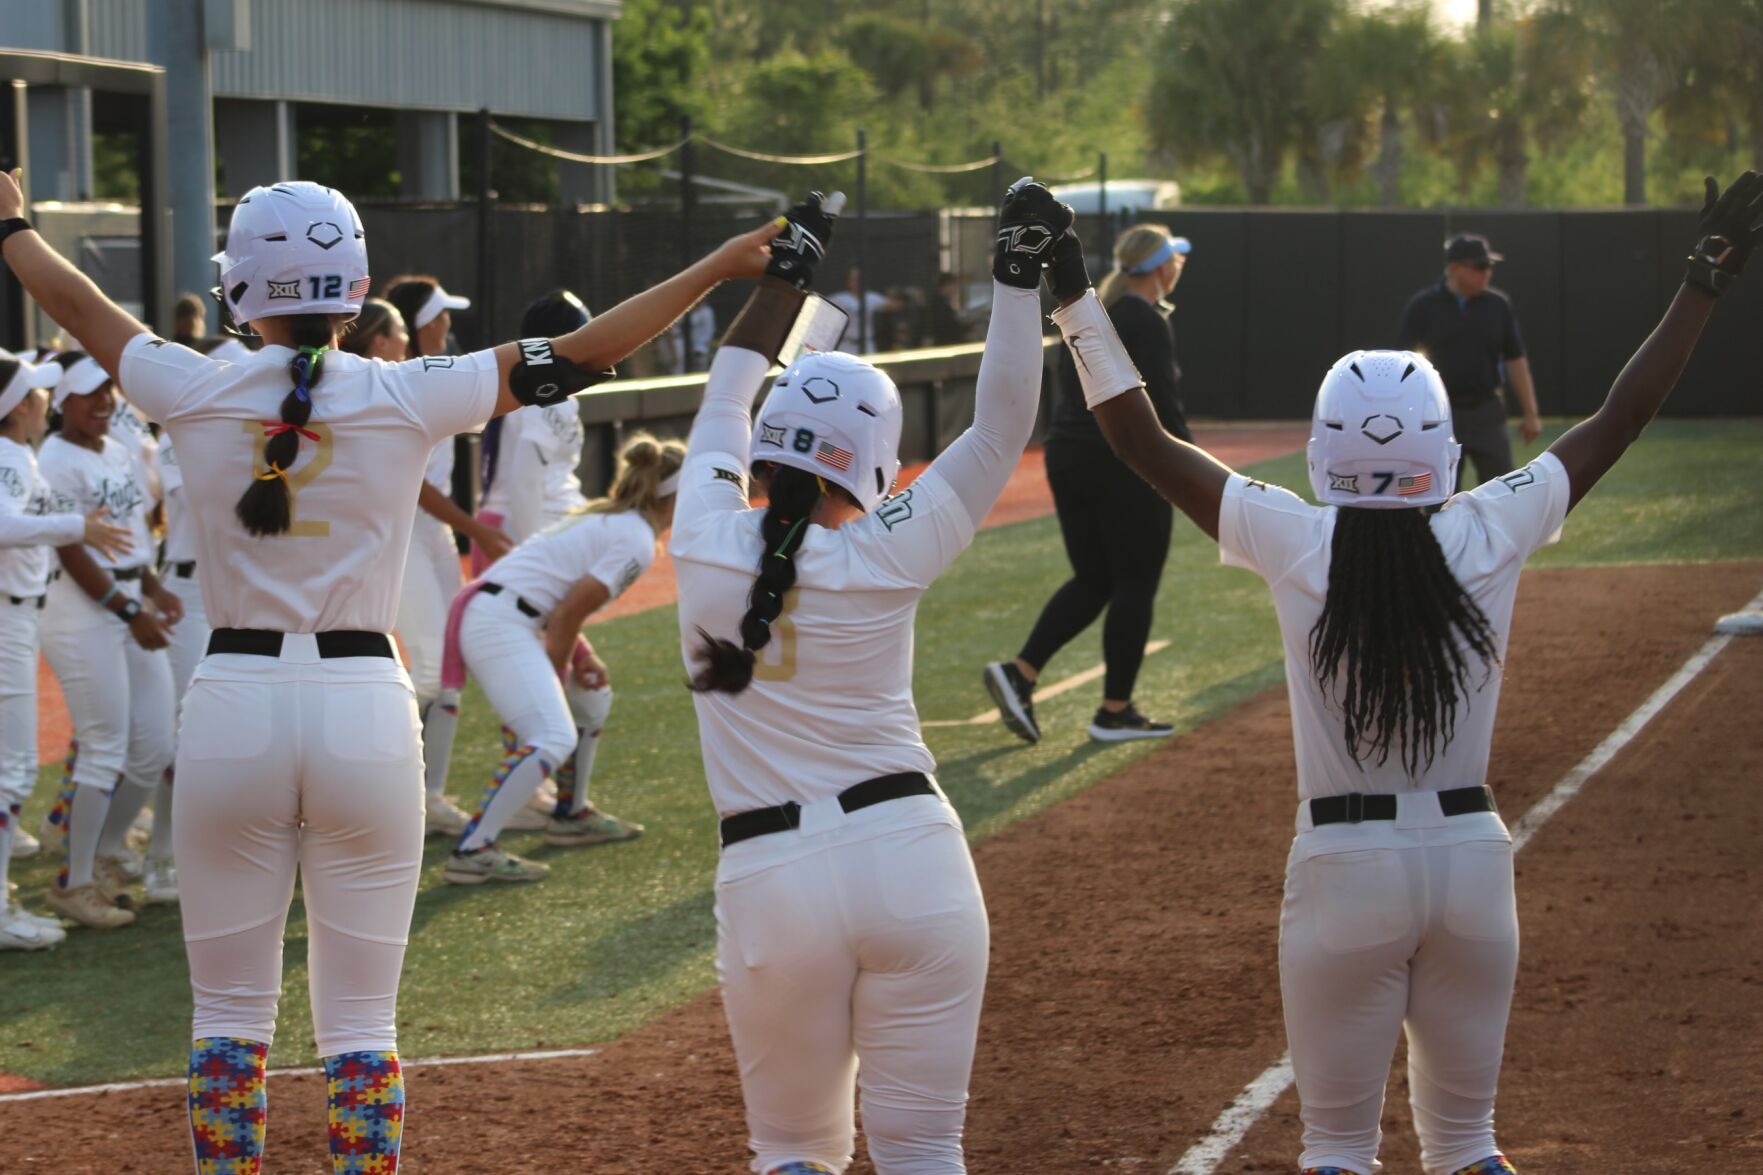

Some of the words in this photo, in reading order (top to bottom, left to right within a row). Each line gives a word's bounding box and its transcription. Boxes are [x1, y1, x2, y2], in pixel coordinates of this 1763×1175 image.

[309, 275, 342, 299] 12
[793, 427, 815, 454] 8
[1371, 471, 1394, 495] 7
